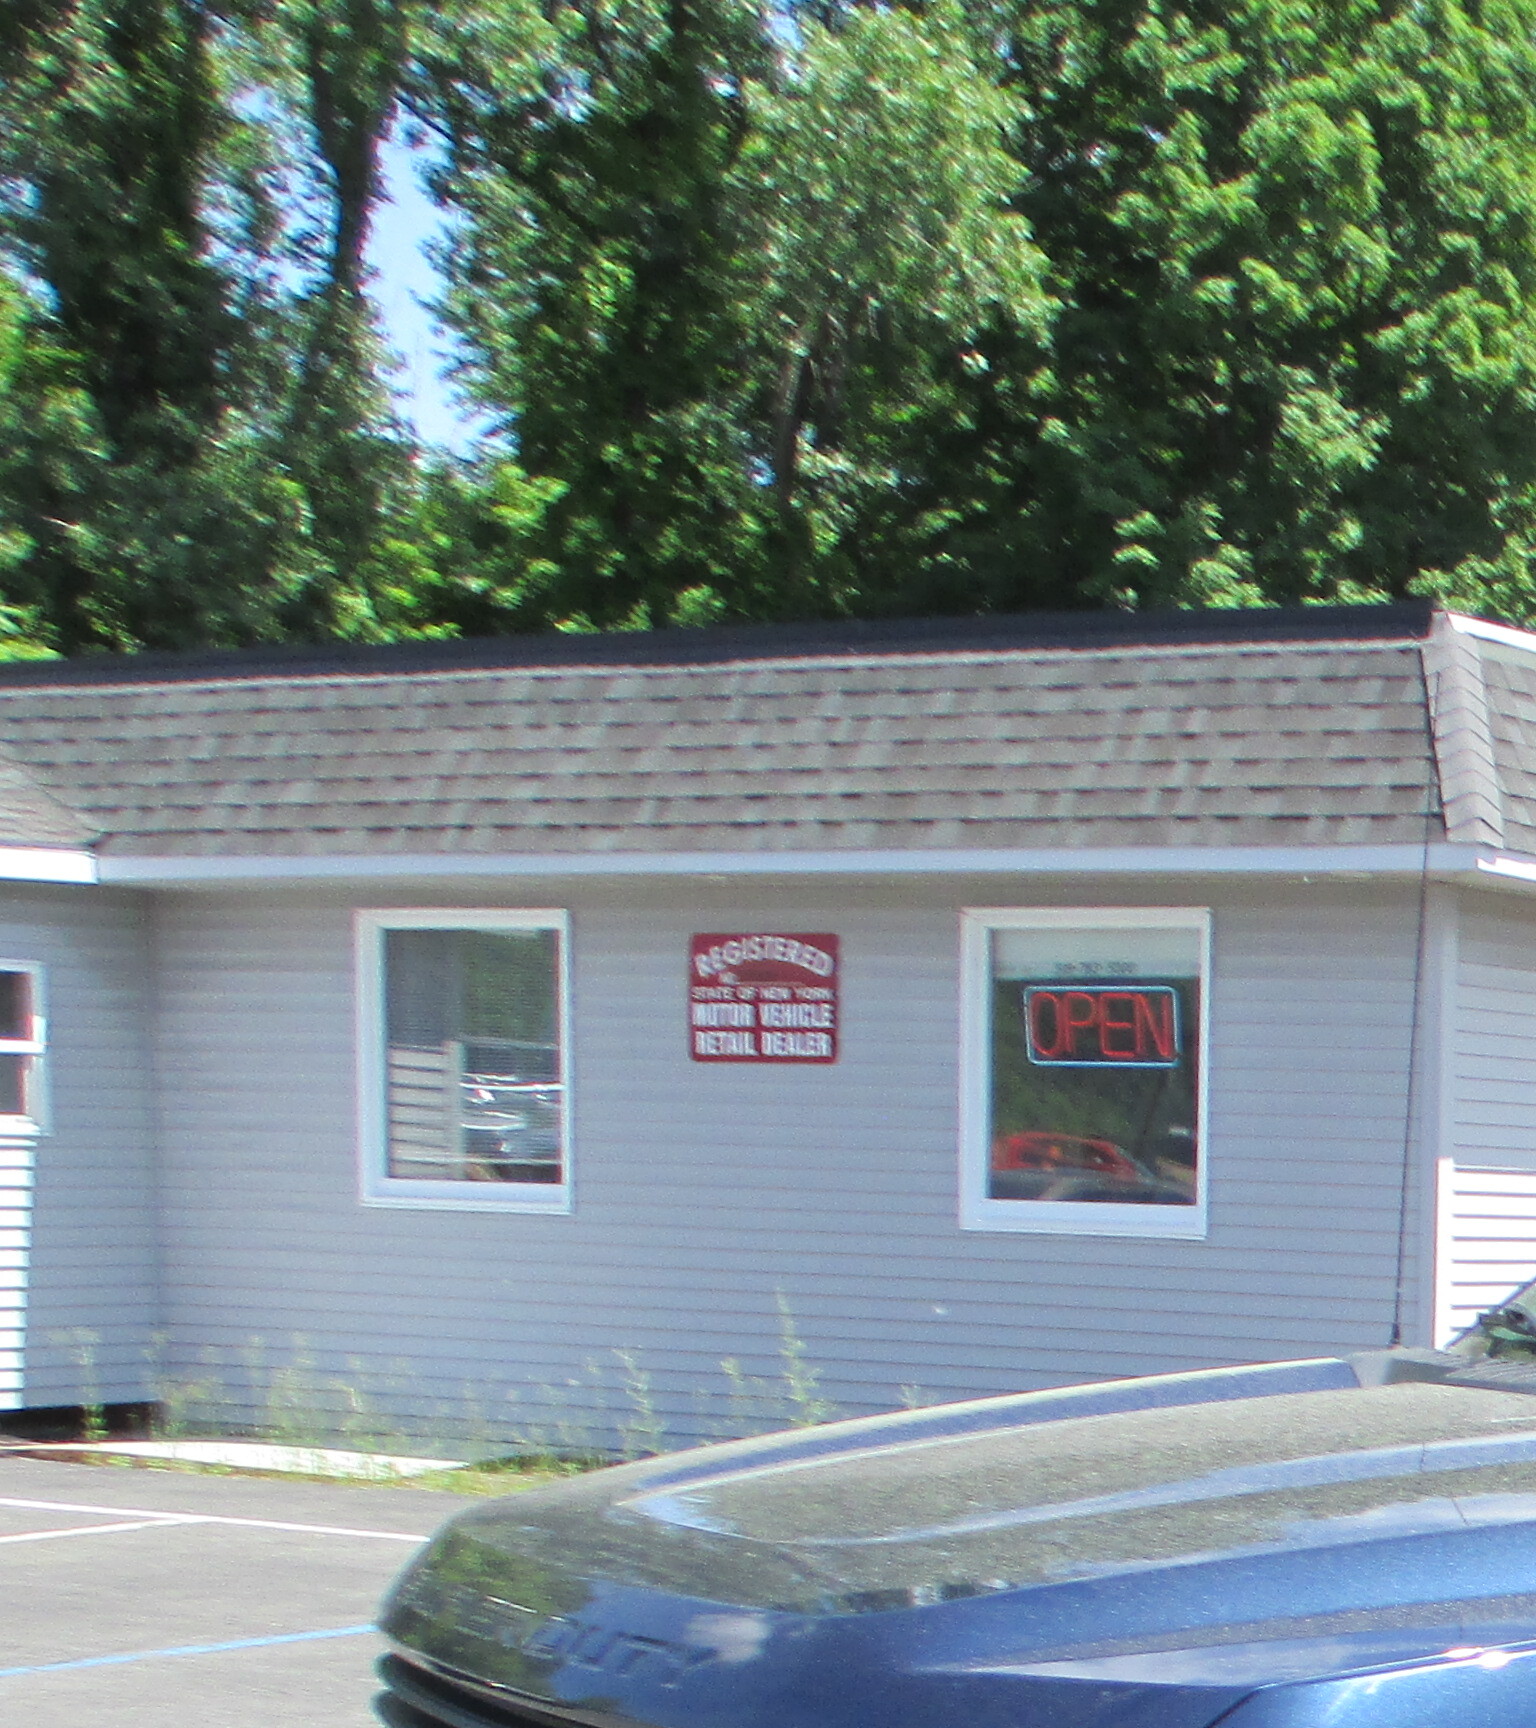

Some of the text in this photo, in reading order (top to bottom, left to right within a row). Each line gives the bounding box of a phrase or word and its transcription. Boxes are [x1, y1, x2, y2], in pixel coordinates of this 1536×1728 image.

[695, 935, 835, 978] REGISTERED
[692, 986, 835, 1000] STATE OF NEW YORK
[692, 1002, 836, 1029] MOTOR VEHICLE
[1030, 991, 1173, 1058] OPEN
[695, 1031, 832, 1057] RETAIL DEALER
